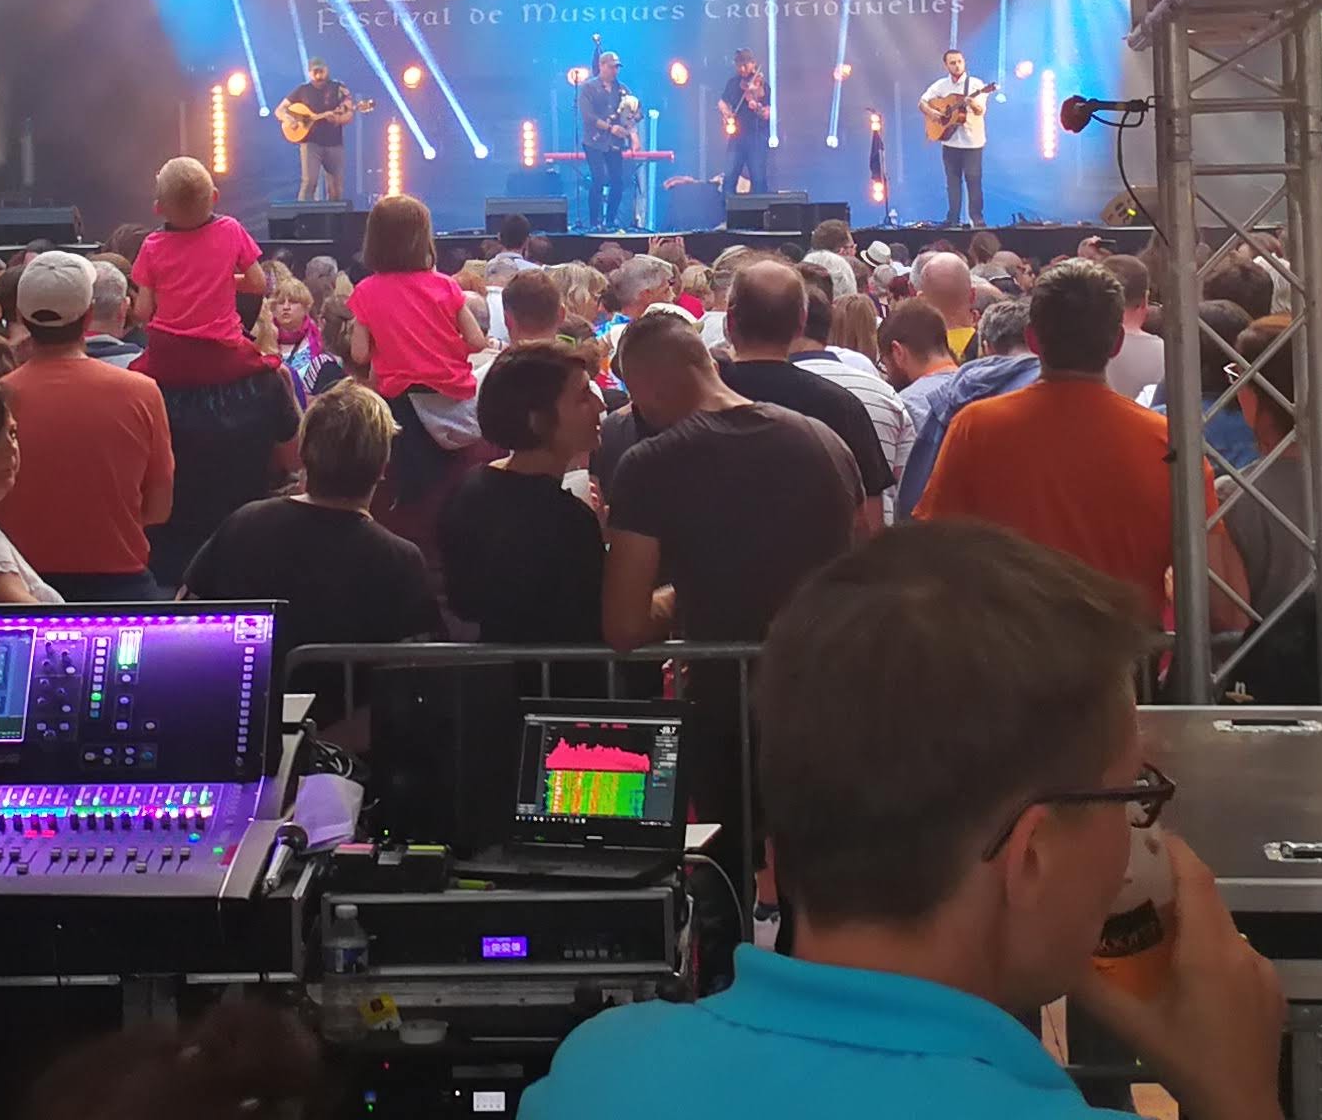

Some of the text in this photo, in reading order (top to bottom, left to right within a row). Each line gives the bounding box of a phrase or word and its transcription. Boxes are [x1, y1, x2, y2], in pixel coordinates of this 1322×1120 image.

[318, 6, 451, 34] Festival
[470, 7, 503, 25] de
[523, 3, 685, 25] Musiques
